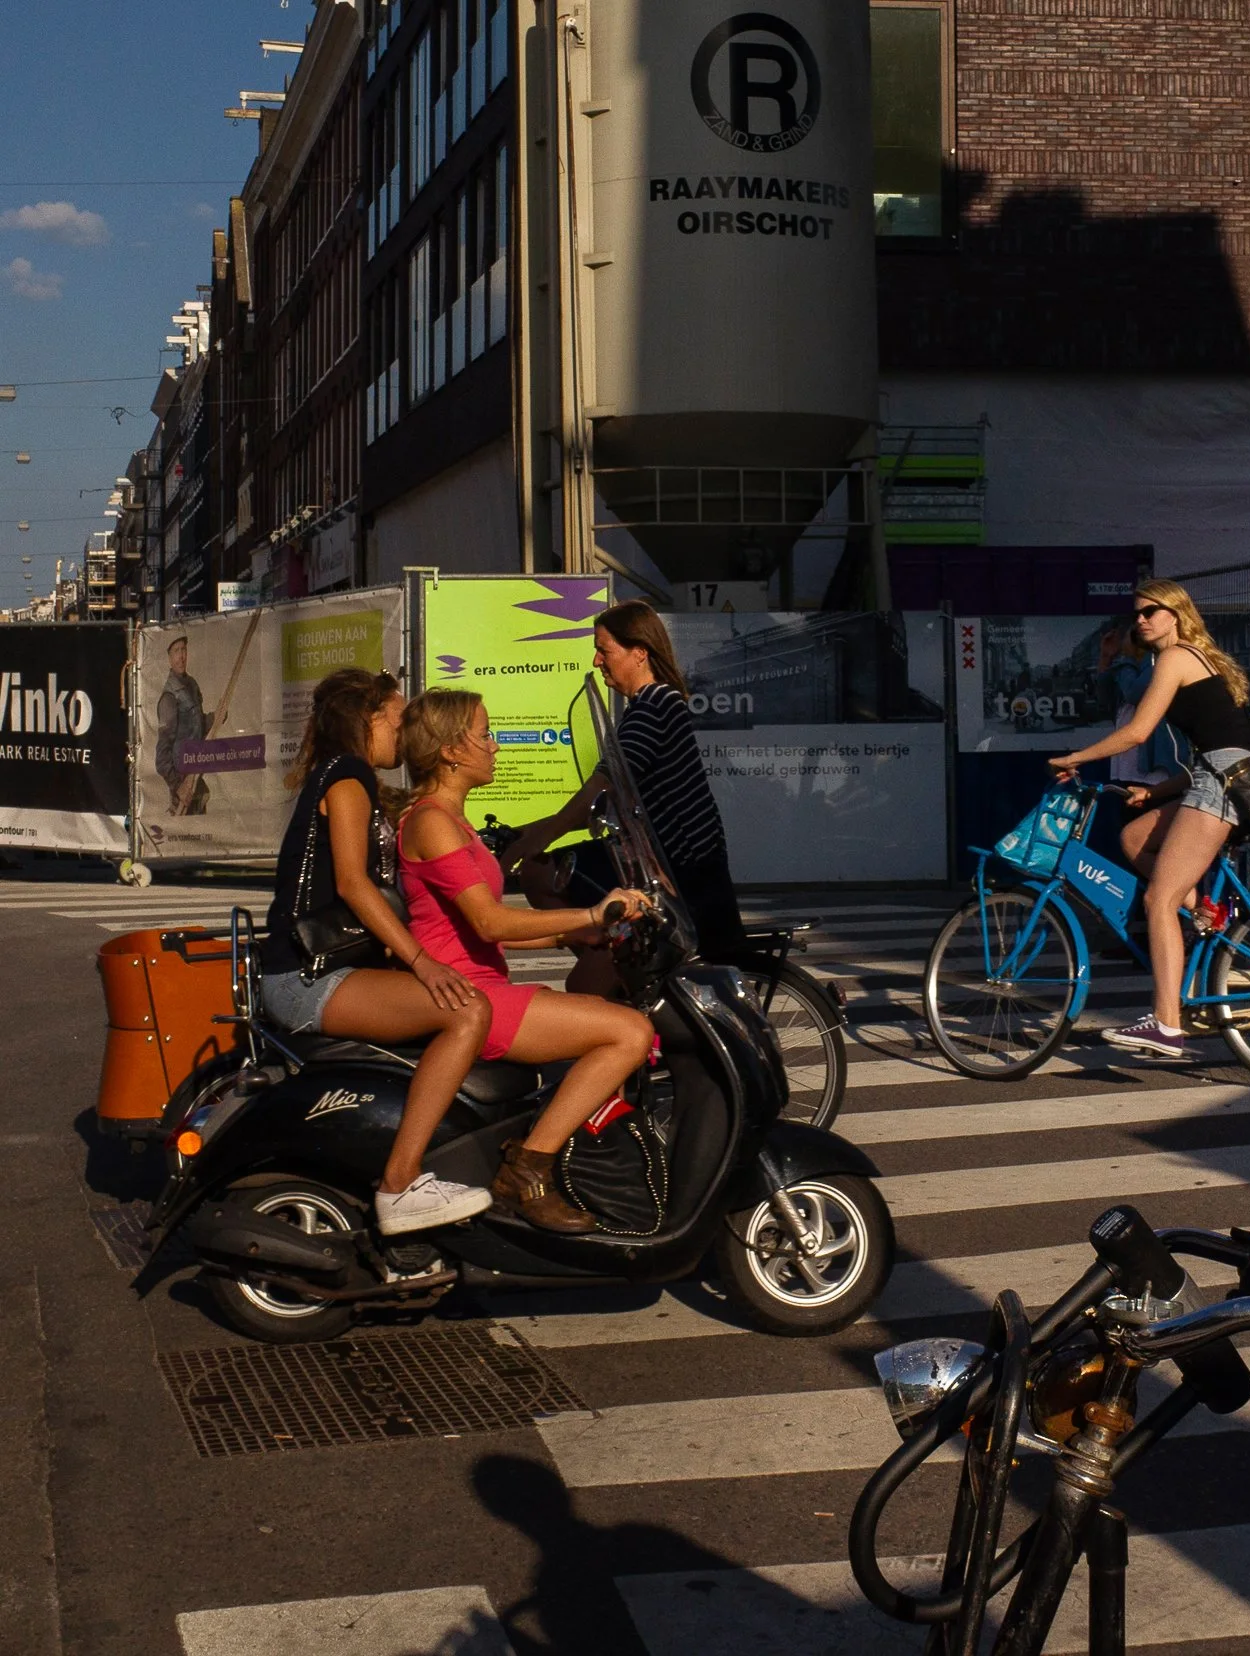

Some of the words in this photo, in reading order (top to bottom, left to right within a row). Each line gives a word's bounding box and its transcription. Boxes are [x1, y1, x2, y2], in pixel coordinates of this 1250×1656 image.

[703, 115, 749, 148] ZAND
[752, 136, 765, 151] &
[769, 114, 815, 151] GRIND
[649, 176, 850, 210] RAAYMAKERS
[677, 211, 834, 240] OIRSCHOT
[691, 583, 718, 607] 17
[296, 628, 343, 648] BOUWEN
[345, 623, 368, 642] AAN
[297, 650, 321, 668] IETS
[322, 646, 357, 665] MOOIS
[474, 666, 496, 676] era
[500, 663, 555, 675] contour
[564, 662, 579, 671] TBI
[687, 692, 754, 714] oen
[993, 691, 1080, 720] toen
[27, 745, 50, 762] REAL
[55, 747, 92, 764] ESTATE
[183, 752, 196, 765] Dat
[197, 752, 215, 763] doen
[715, 744, 742, 758] hier
[746, 744, 769, 757] het
[774, 743, 859, 757] beroemdste
[864, 742, 911, 759] biertje
[703, 763, 722, 777] de
[726, 763, 775, 776] wereld
[780, 762, 861, 779] gebrouwen
[0, 825, 25, 836] ontour
[308, 1088, 358, 1114] Mio
[359, 1094, 375, 1102] 50
